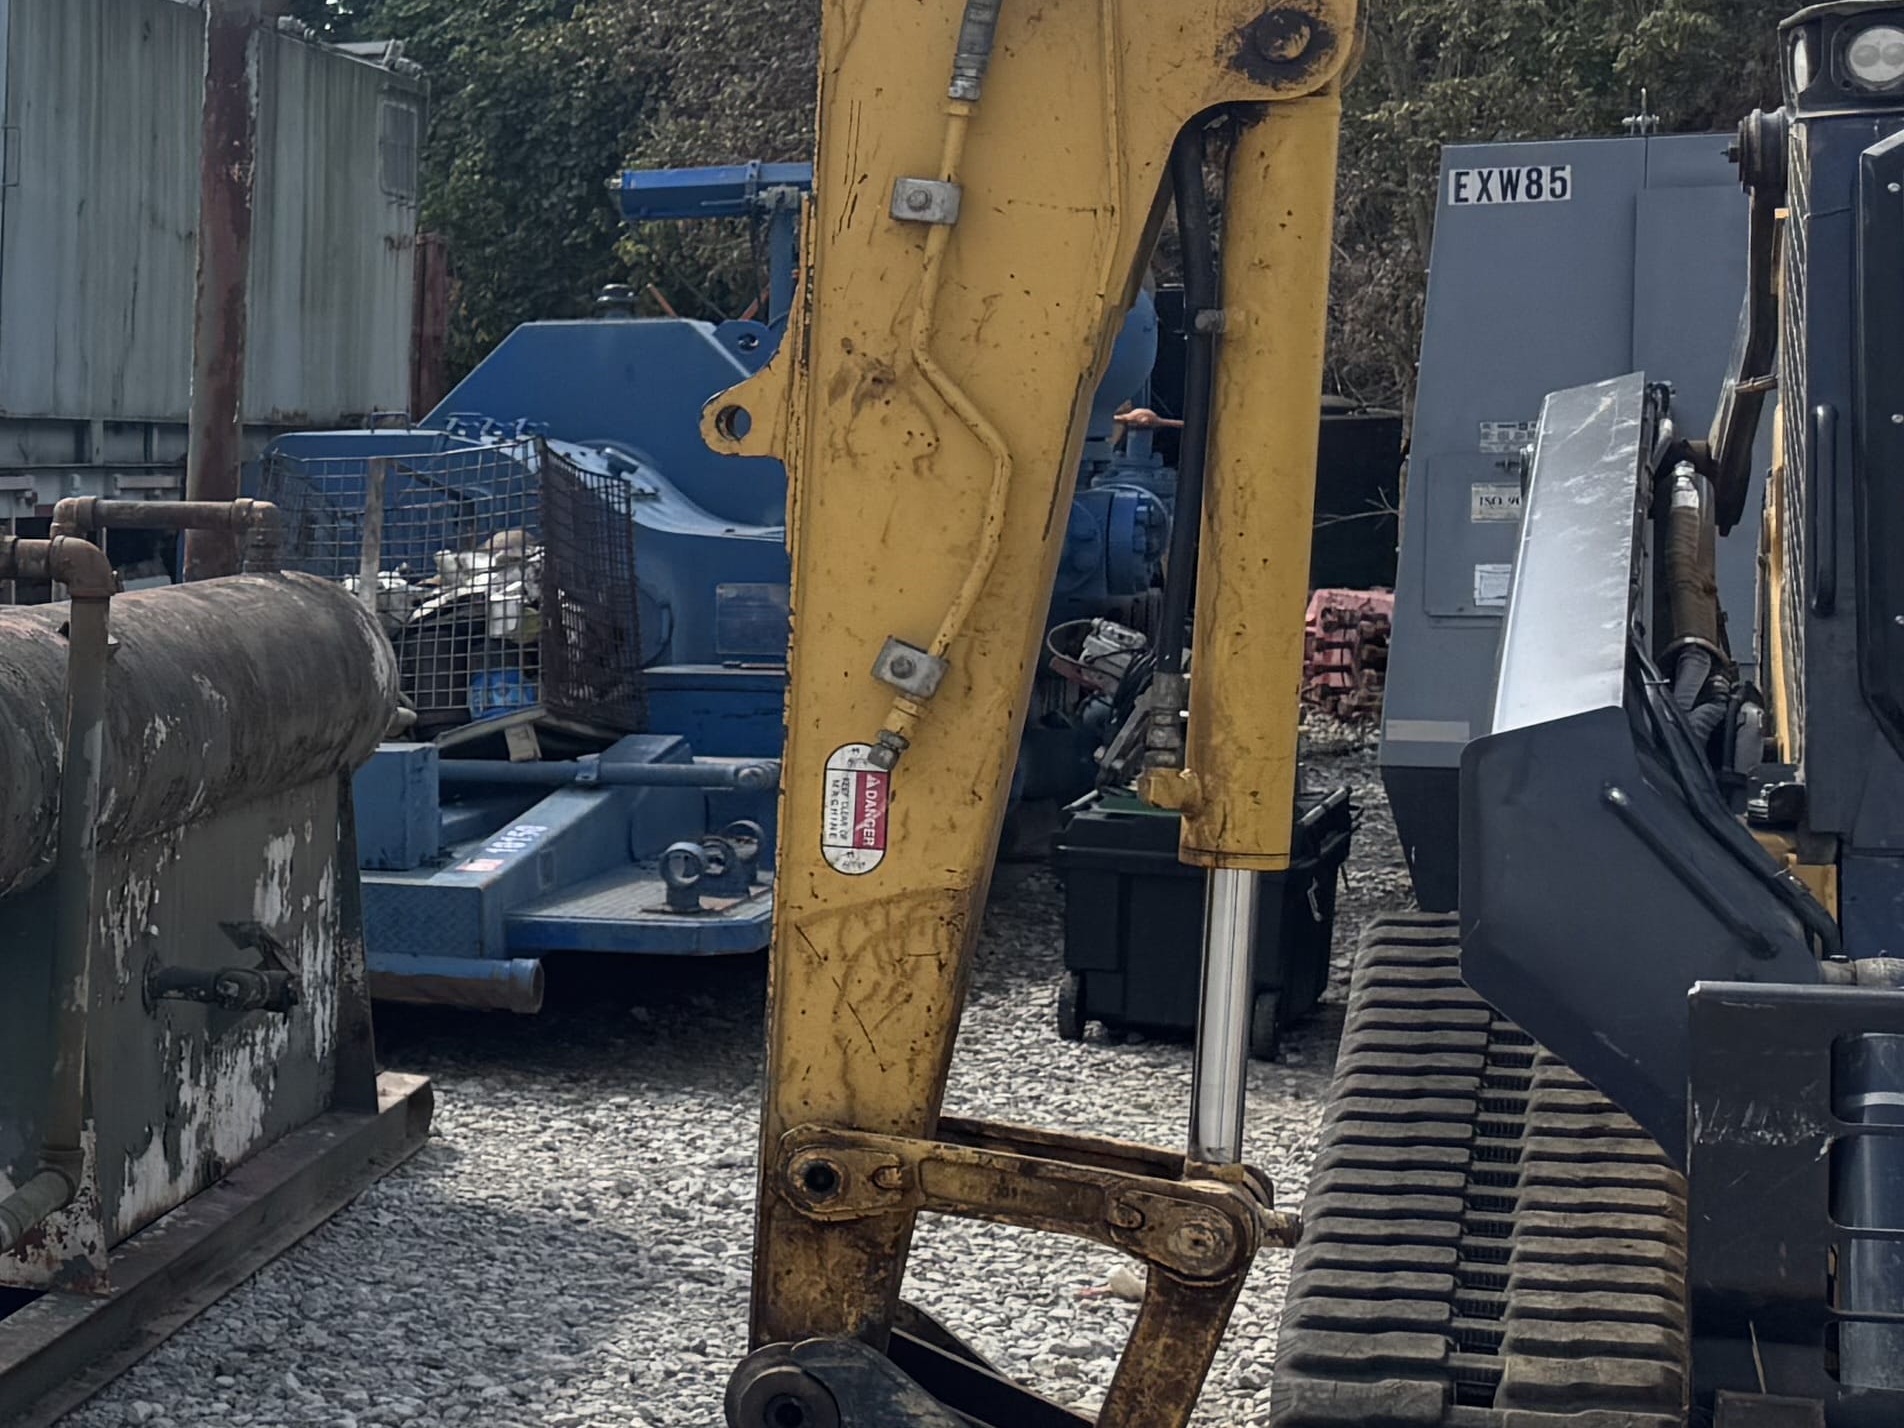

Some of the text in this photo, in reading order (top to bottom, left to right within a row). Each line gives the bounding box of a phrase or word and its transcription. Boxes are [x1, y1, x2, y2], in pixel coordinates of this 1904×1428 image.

[1454, 165, 1568, 203] EXW85
[1479, 495, 1502, 507] ISO
[829, 779, 840, 840] MACHINE
[863, 790, 878, 846] DANGER
